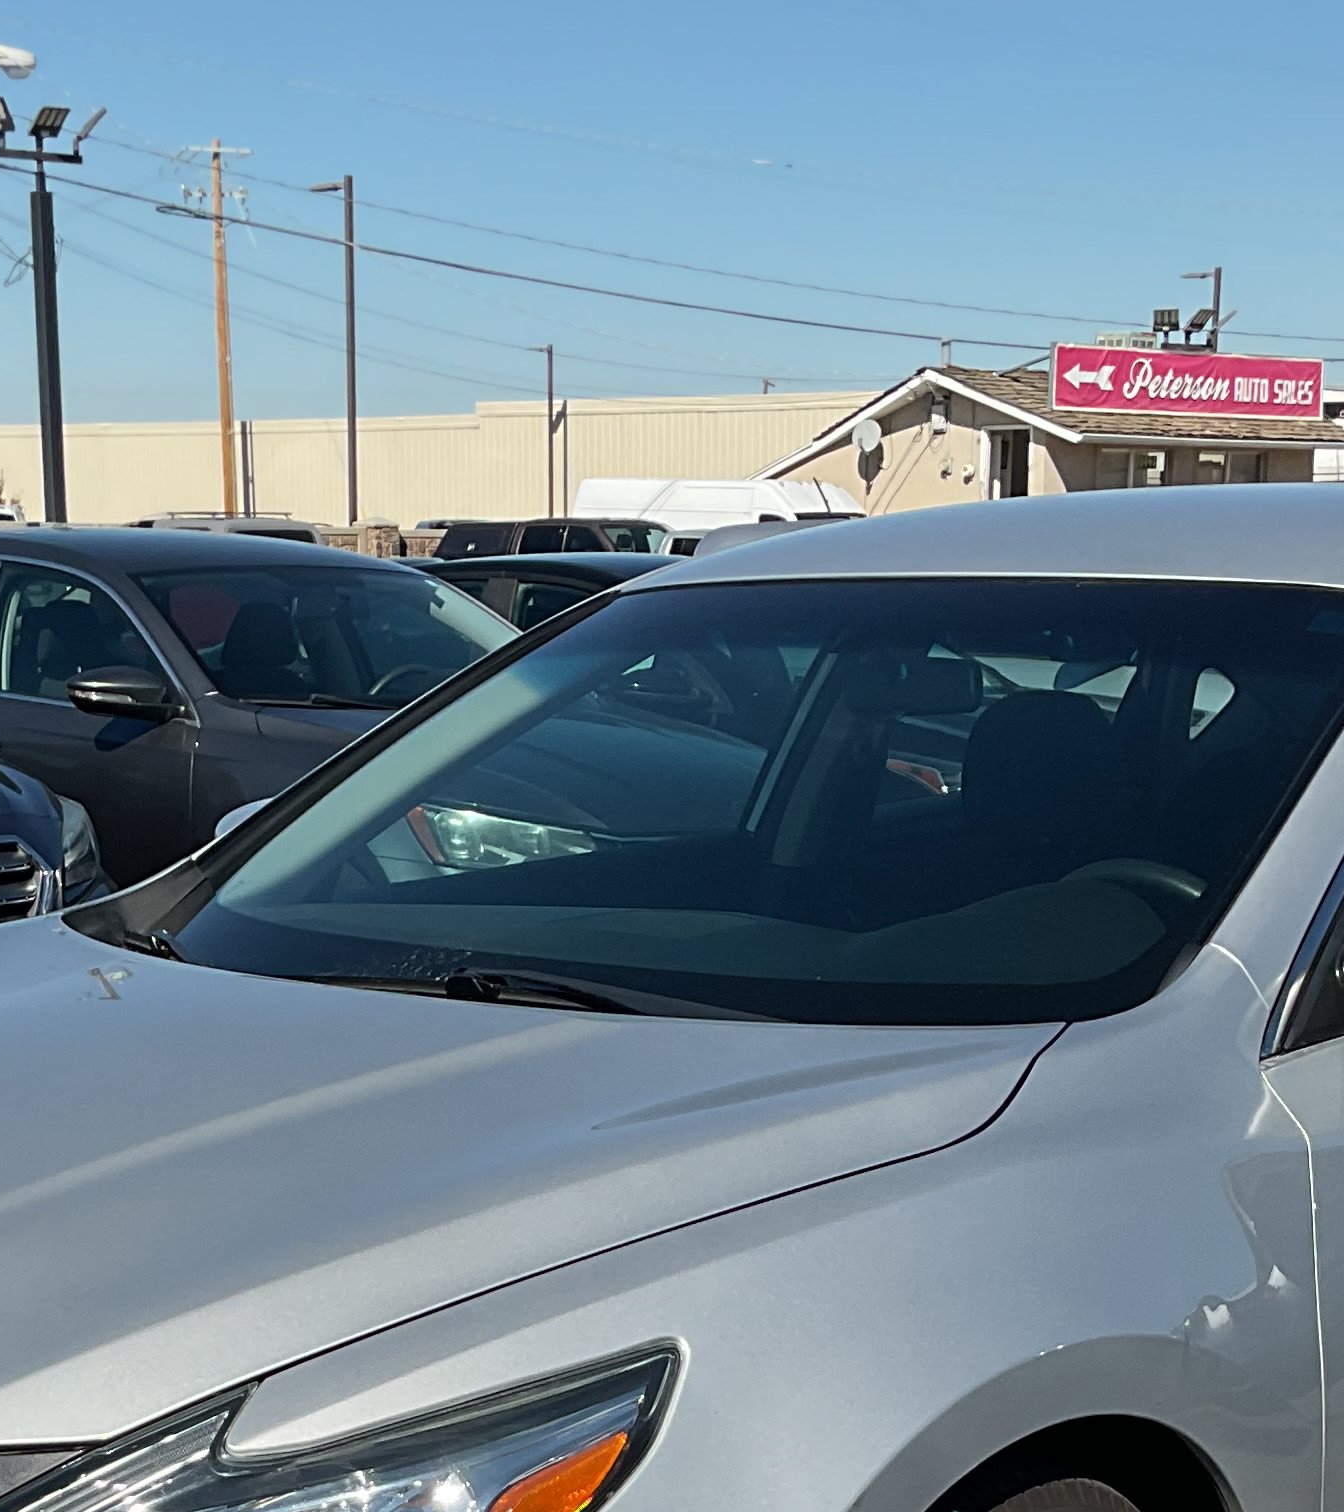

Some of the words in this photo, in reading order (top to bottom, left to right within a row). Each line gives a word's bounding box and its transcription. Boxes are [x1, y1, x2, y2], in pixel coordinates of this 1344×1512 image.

[1122, 358, 1231, 401] Peterson
[1233, 377, 1270, 404] AUTO
[1272, 379, 1315, 406] SALES
